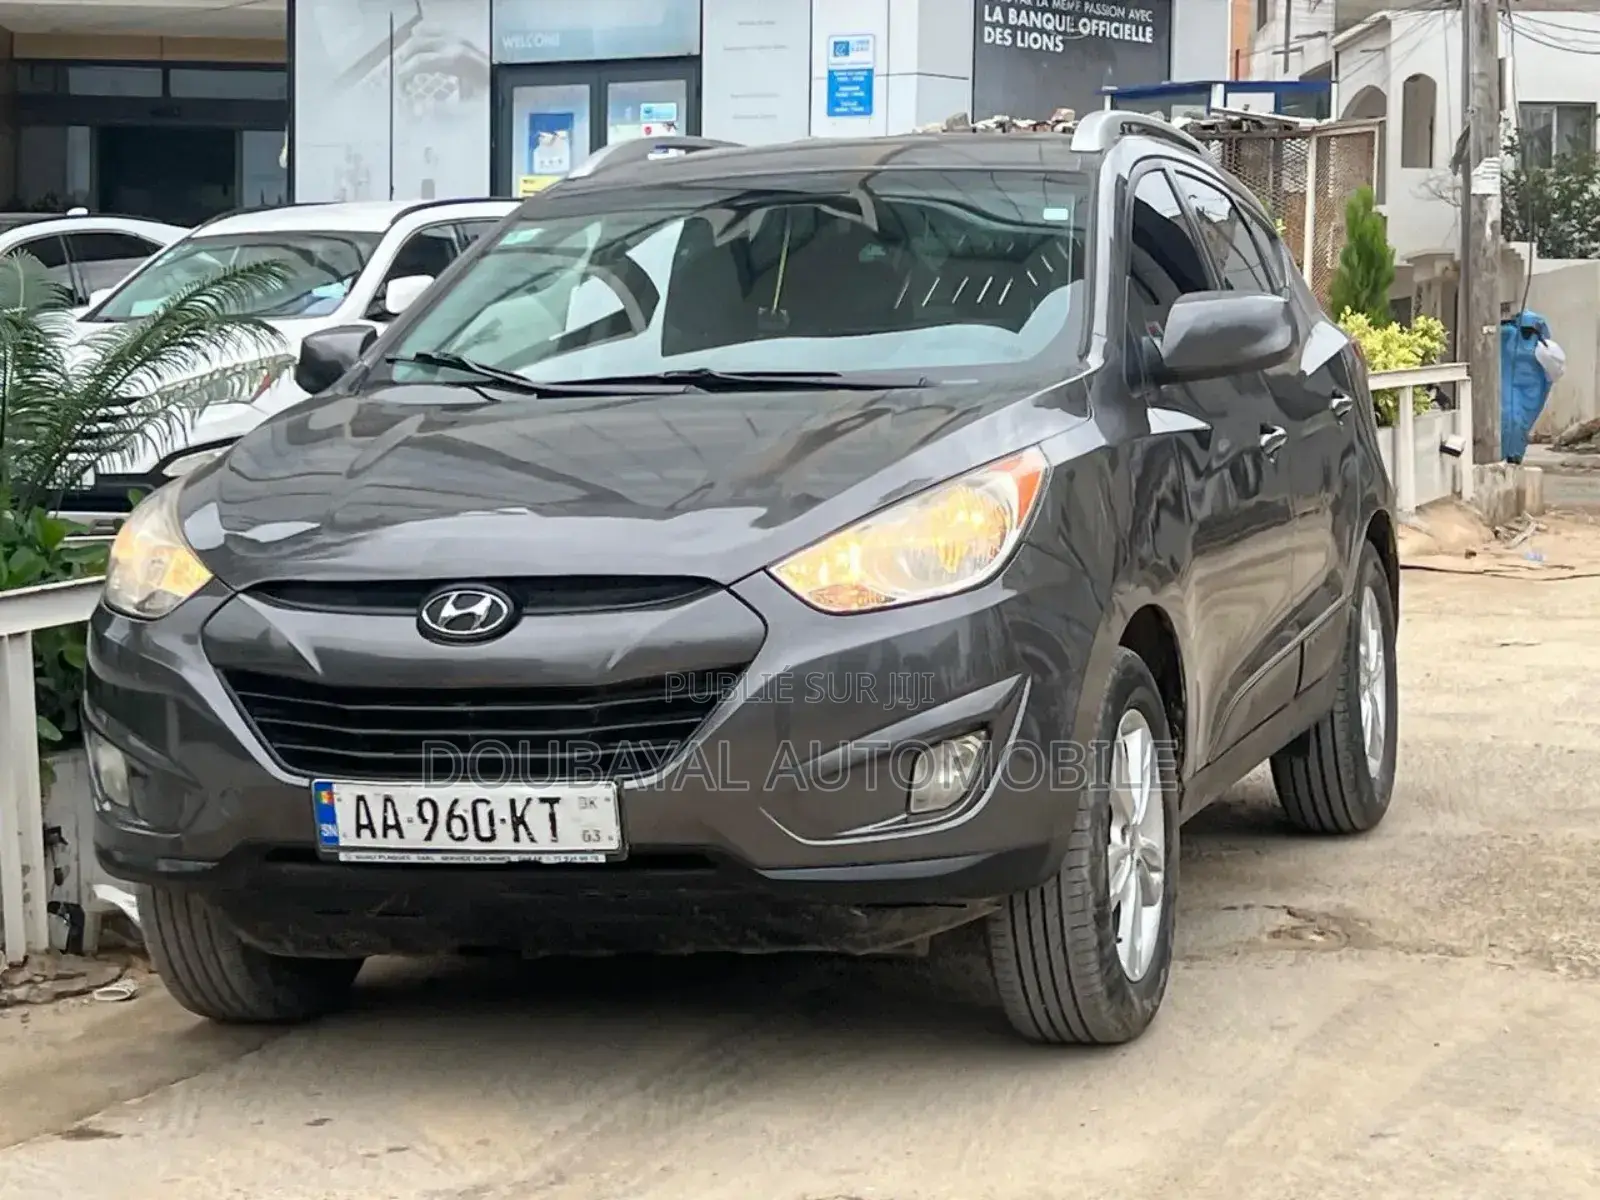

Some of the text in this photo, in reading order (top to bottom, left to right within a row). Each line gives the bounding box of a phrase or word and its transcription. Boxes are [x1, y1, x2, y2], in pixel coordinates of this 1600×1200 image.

[984, 4, 1153, 43] LA BANQUE OFFICIELLE
[1084, 1, 1126, 18] PASSION
[1128, 8, 1153, 22] AVEC
[984, 25, 1064, 52] DES LIONS
